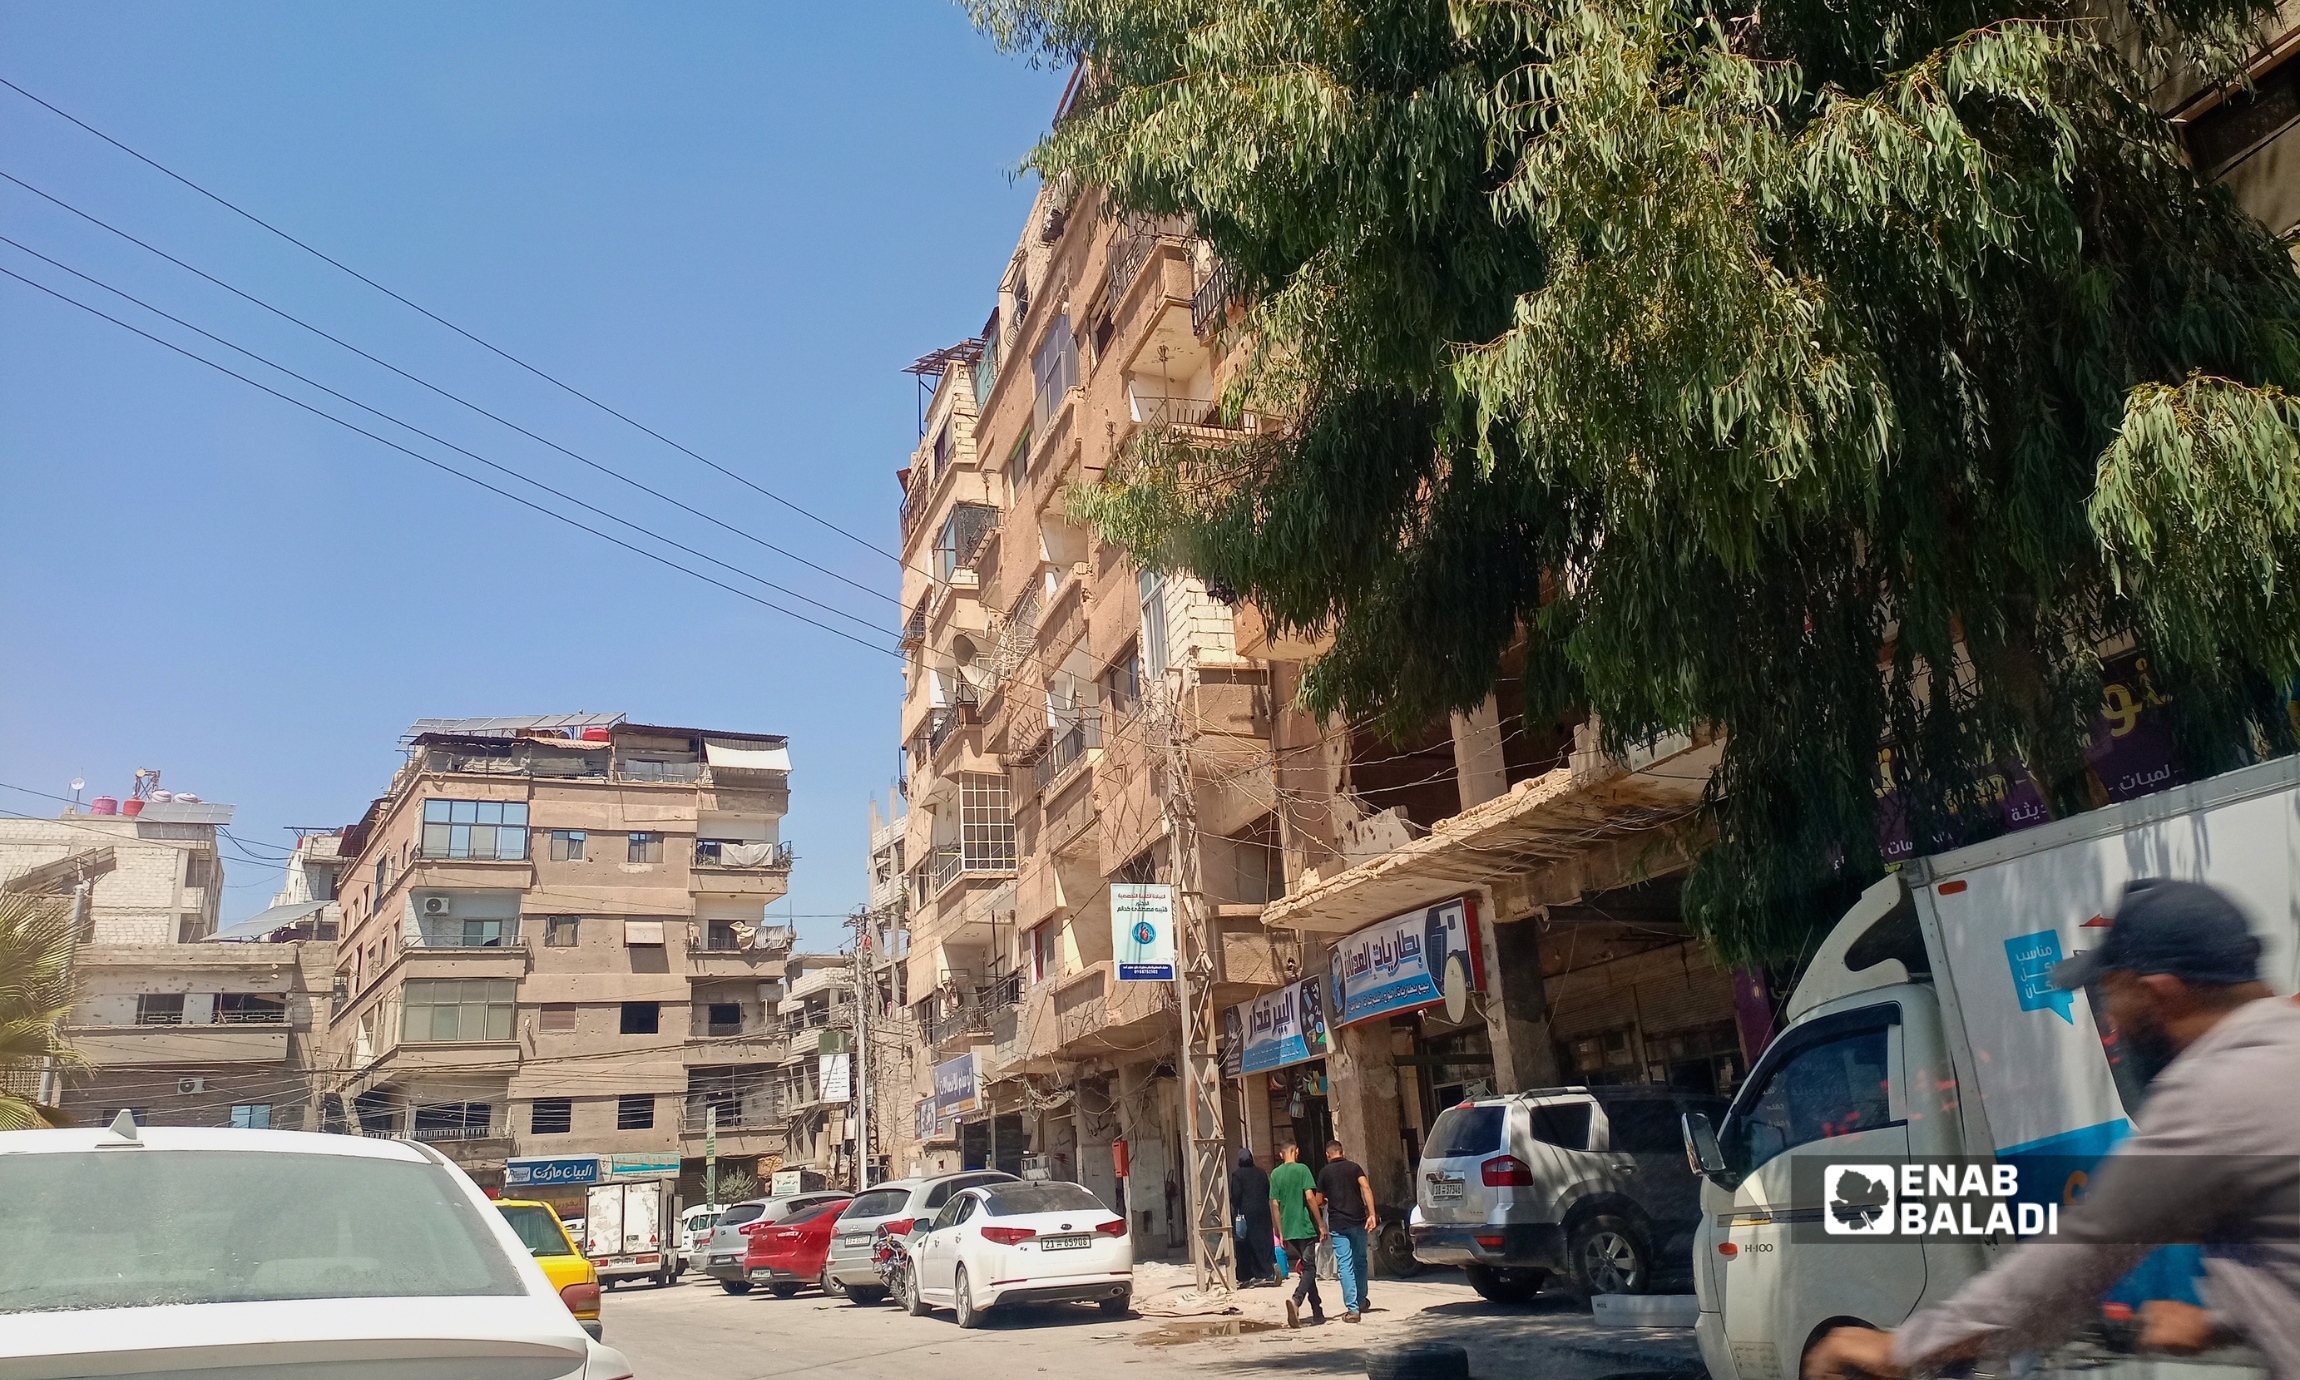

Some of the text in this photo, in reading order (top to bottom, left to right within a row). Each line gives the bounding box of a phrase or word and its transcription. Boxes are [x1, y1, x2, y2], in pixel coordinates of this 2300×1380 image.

[2119, 763, 2171, 791] لمبات
[2011, 801, 2048, 822] ديثة
[1373, 929, 1423, 973] بطاريات
[2016, 945, 2053, 965] مناسب
[532, 1163, 562, 1181] ماركت
[562, 1163, 593, 1180] البيان
